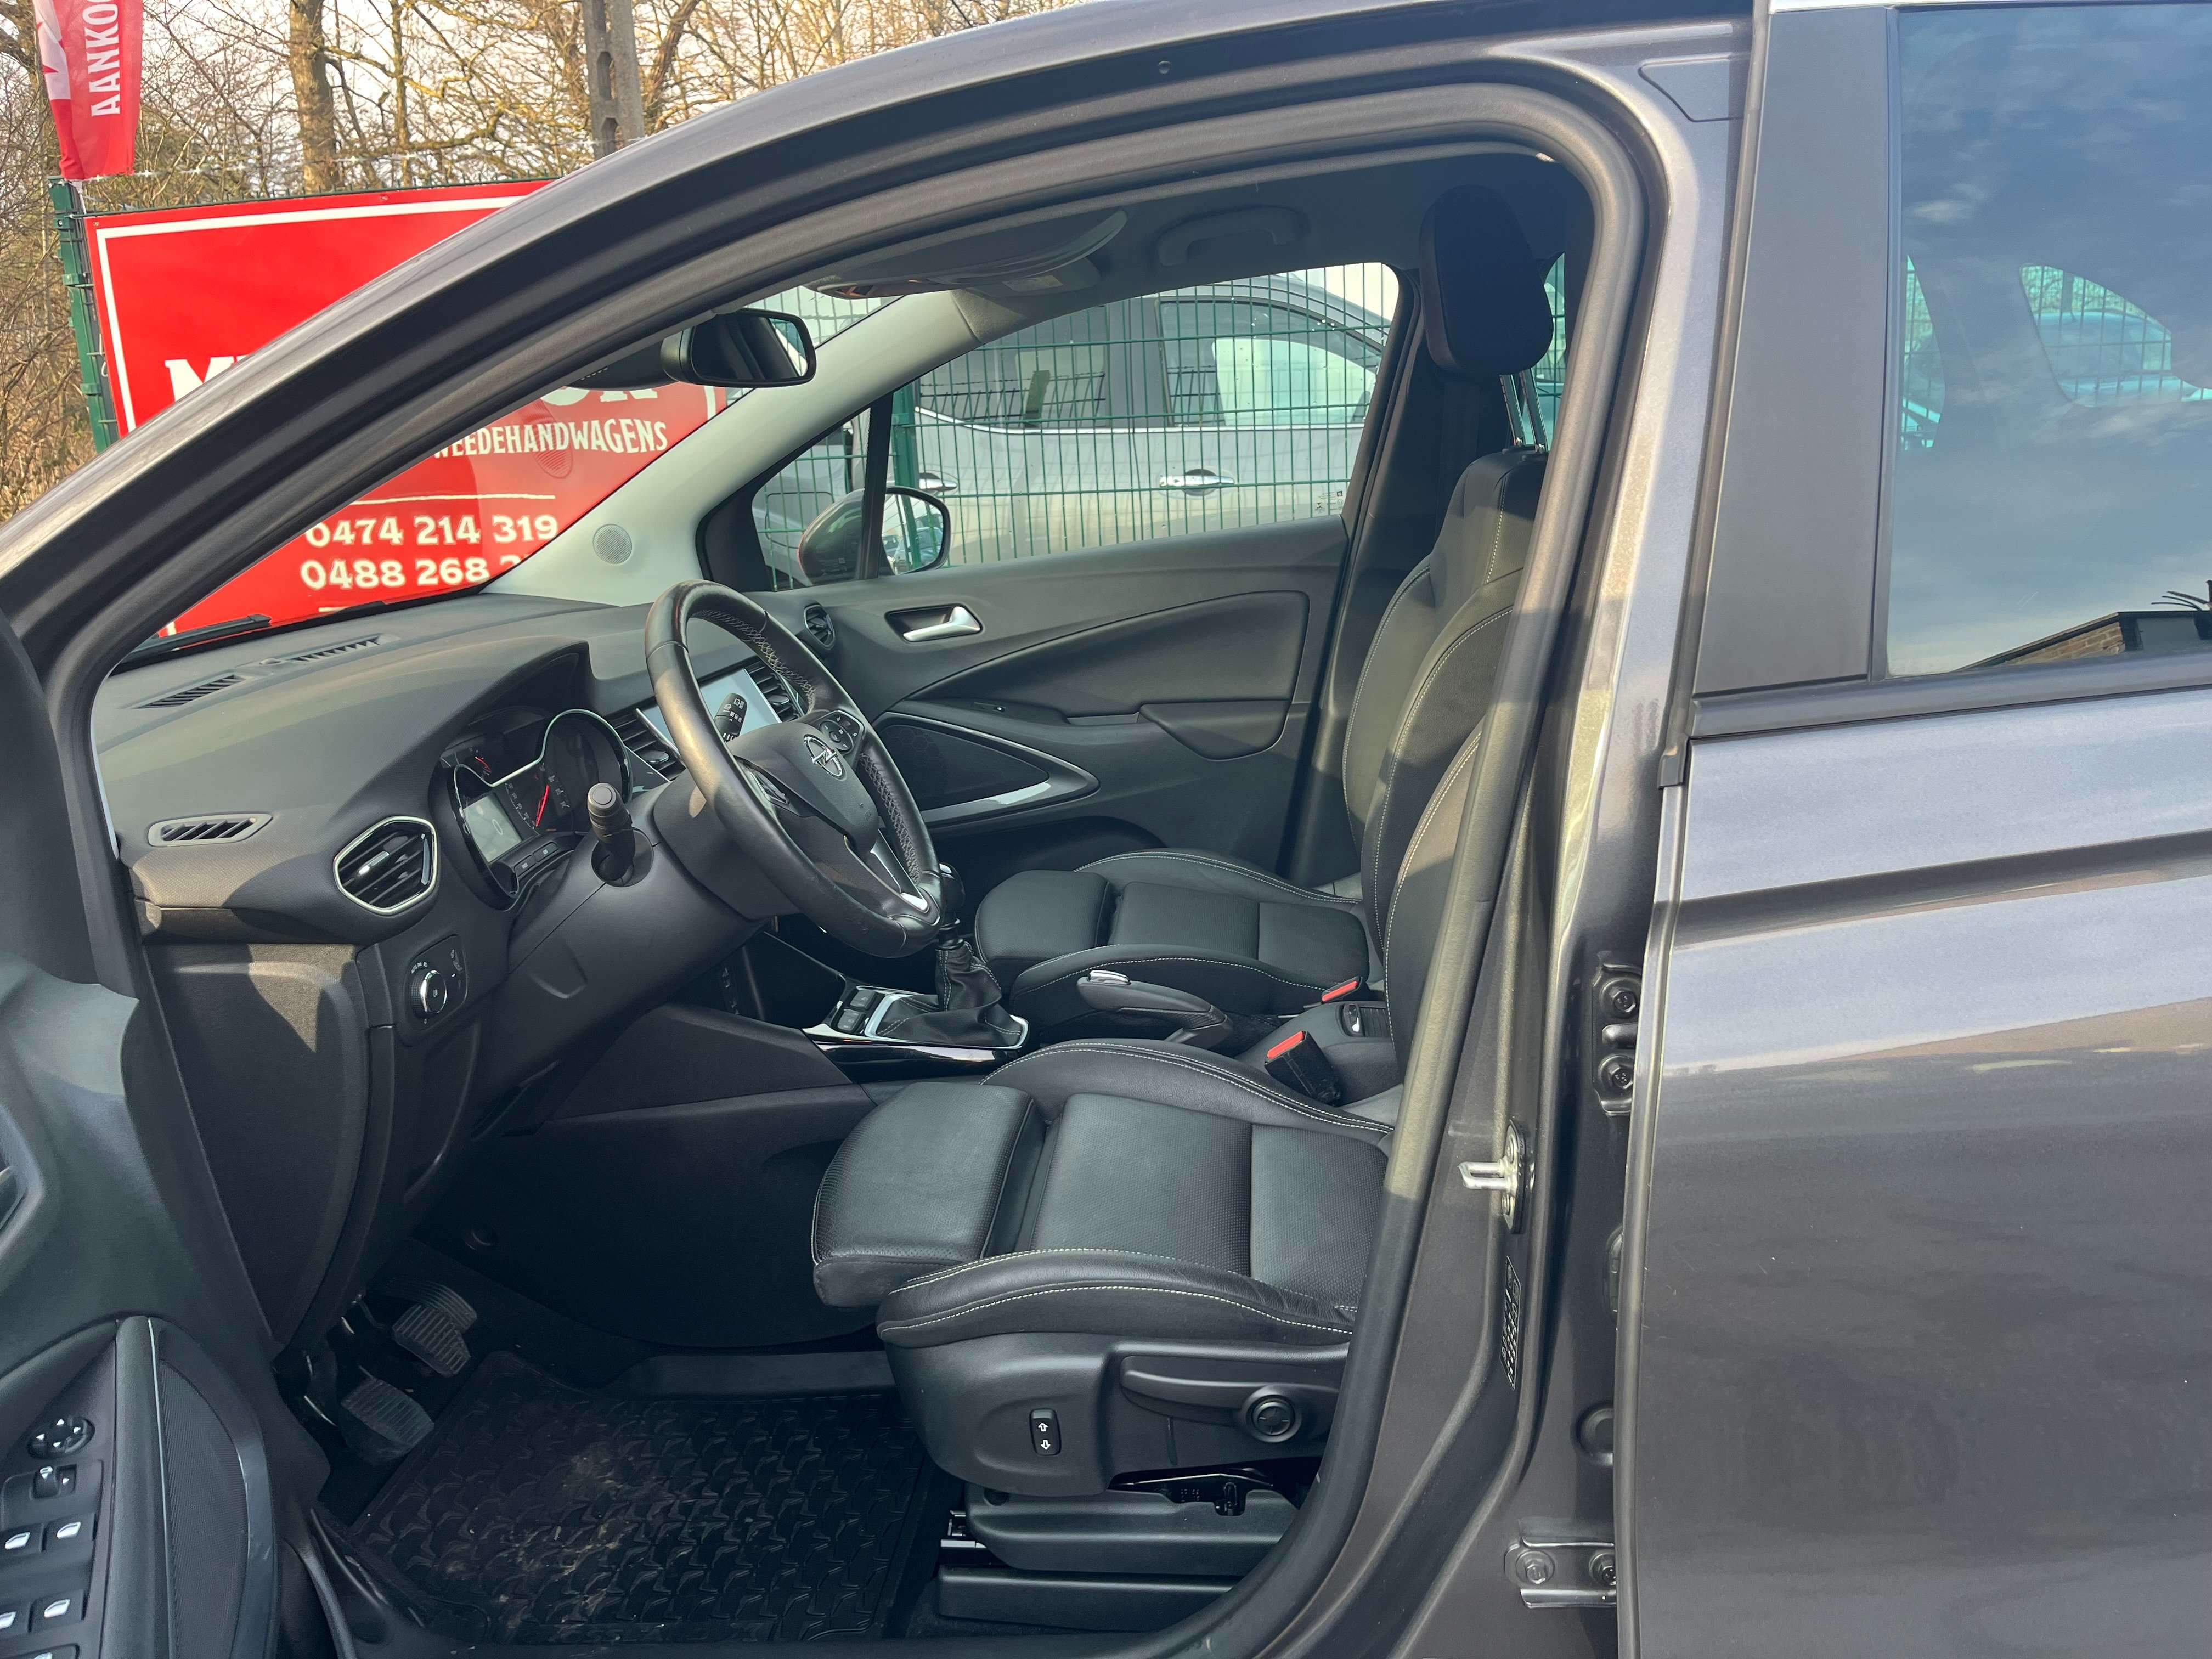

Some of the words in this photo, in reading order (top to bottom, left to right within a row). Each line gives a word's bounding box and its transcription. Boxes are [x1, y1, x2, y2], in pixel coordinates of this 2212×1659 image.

[82, 0, 121, 117] AANKO
[304, 515, 403, 548] 0474
[413, 514, 481, 545] 214
[492, 514, 558, 543] 319
[300, 558, 406, 590] 0488
[415, 556, 491, 586] 268
